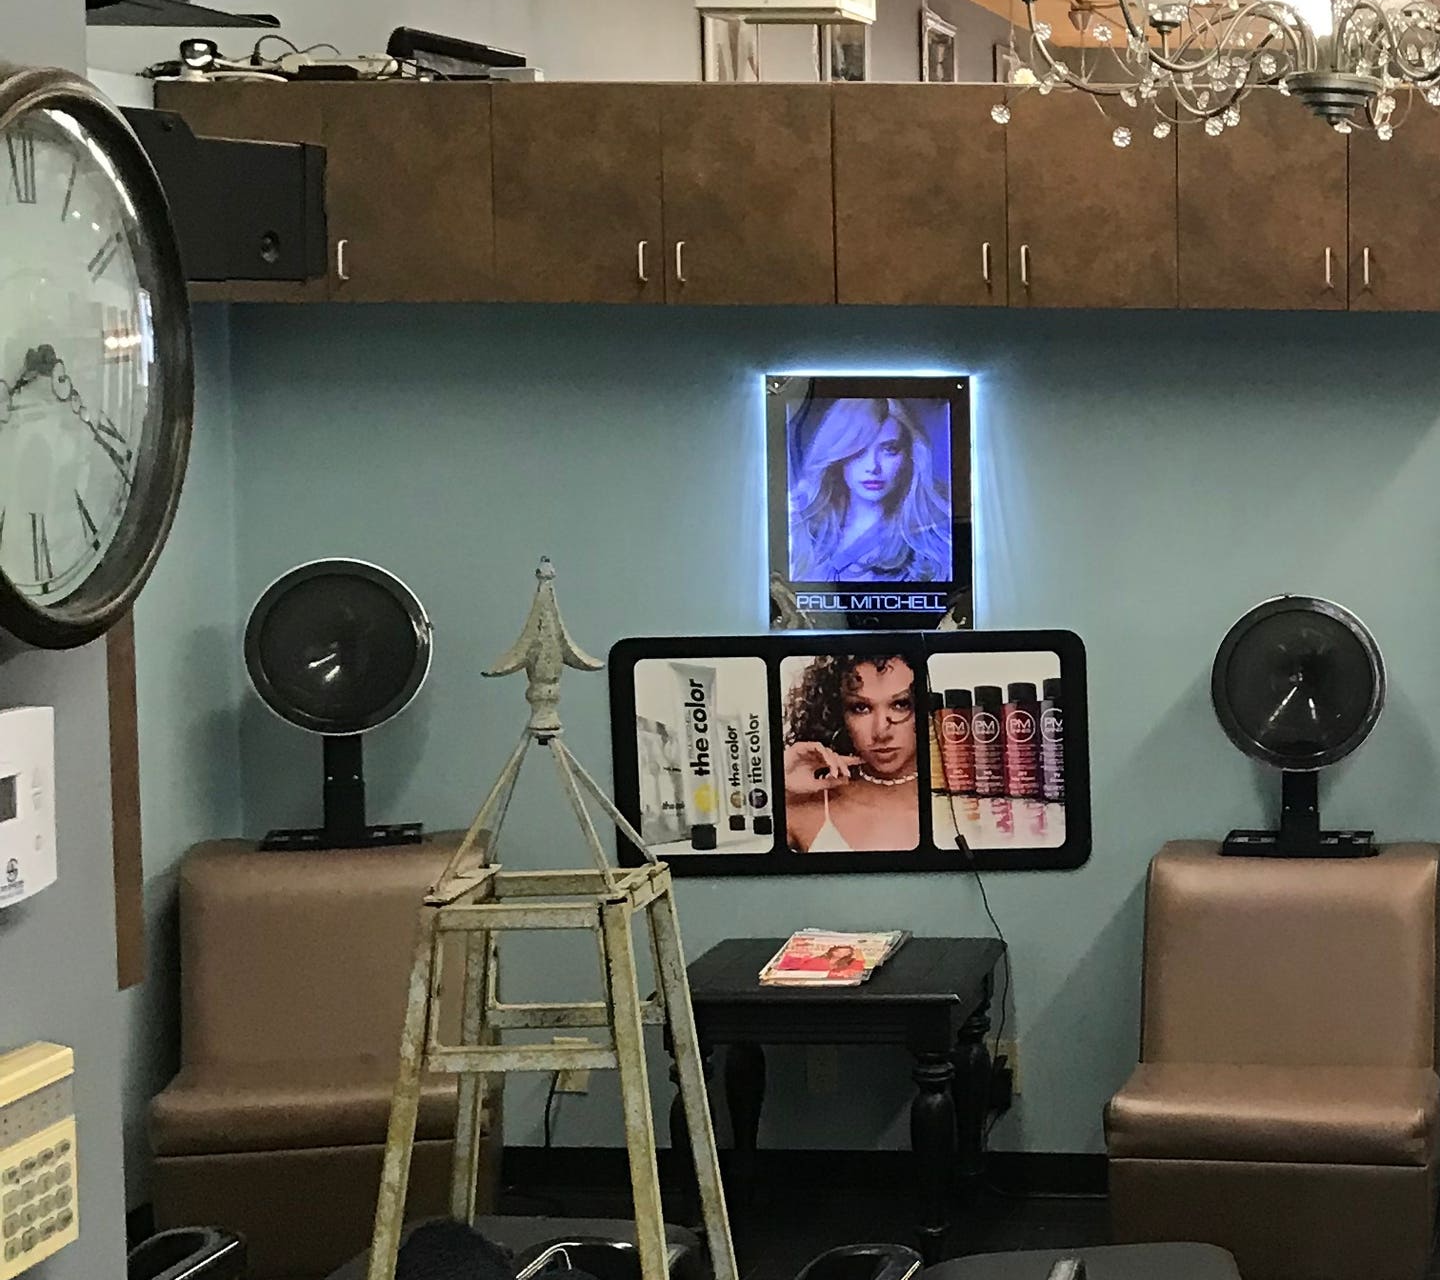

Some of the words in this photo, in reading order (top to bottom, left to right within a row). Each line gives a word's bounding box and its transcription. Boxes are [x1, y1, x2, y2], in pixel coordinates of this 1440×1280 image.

[796, 595, 848, 609] PAUL
[850, 595, 947, 609] MITCHELL
[684, 678, 708, 734] color
[745, 713, 761, 753] color
[974, 720, 995, 731] PM
[1010, 719, 1031, 730] PM
[689, 738, 711, 777] the
[725, 725, 740, 760] color
[728, 762, 741, 787] the
